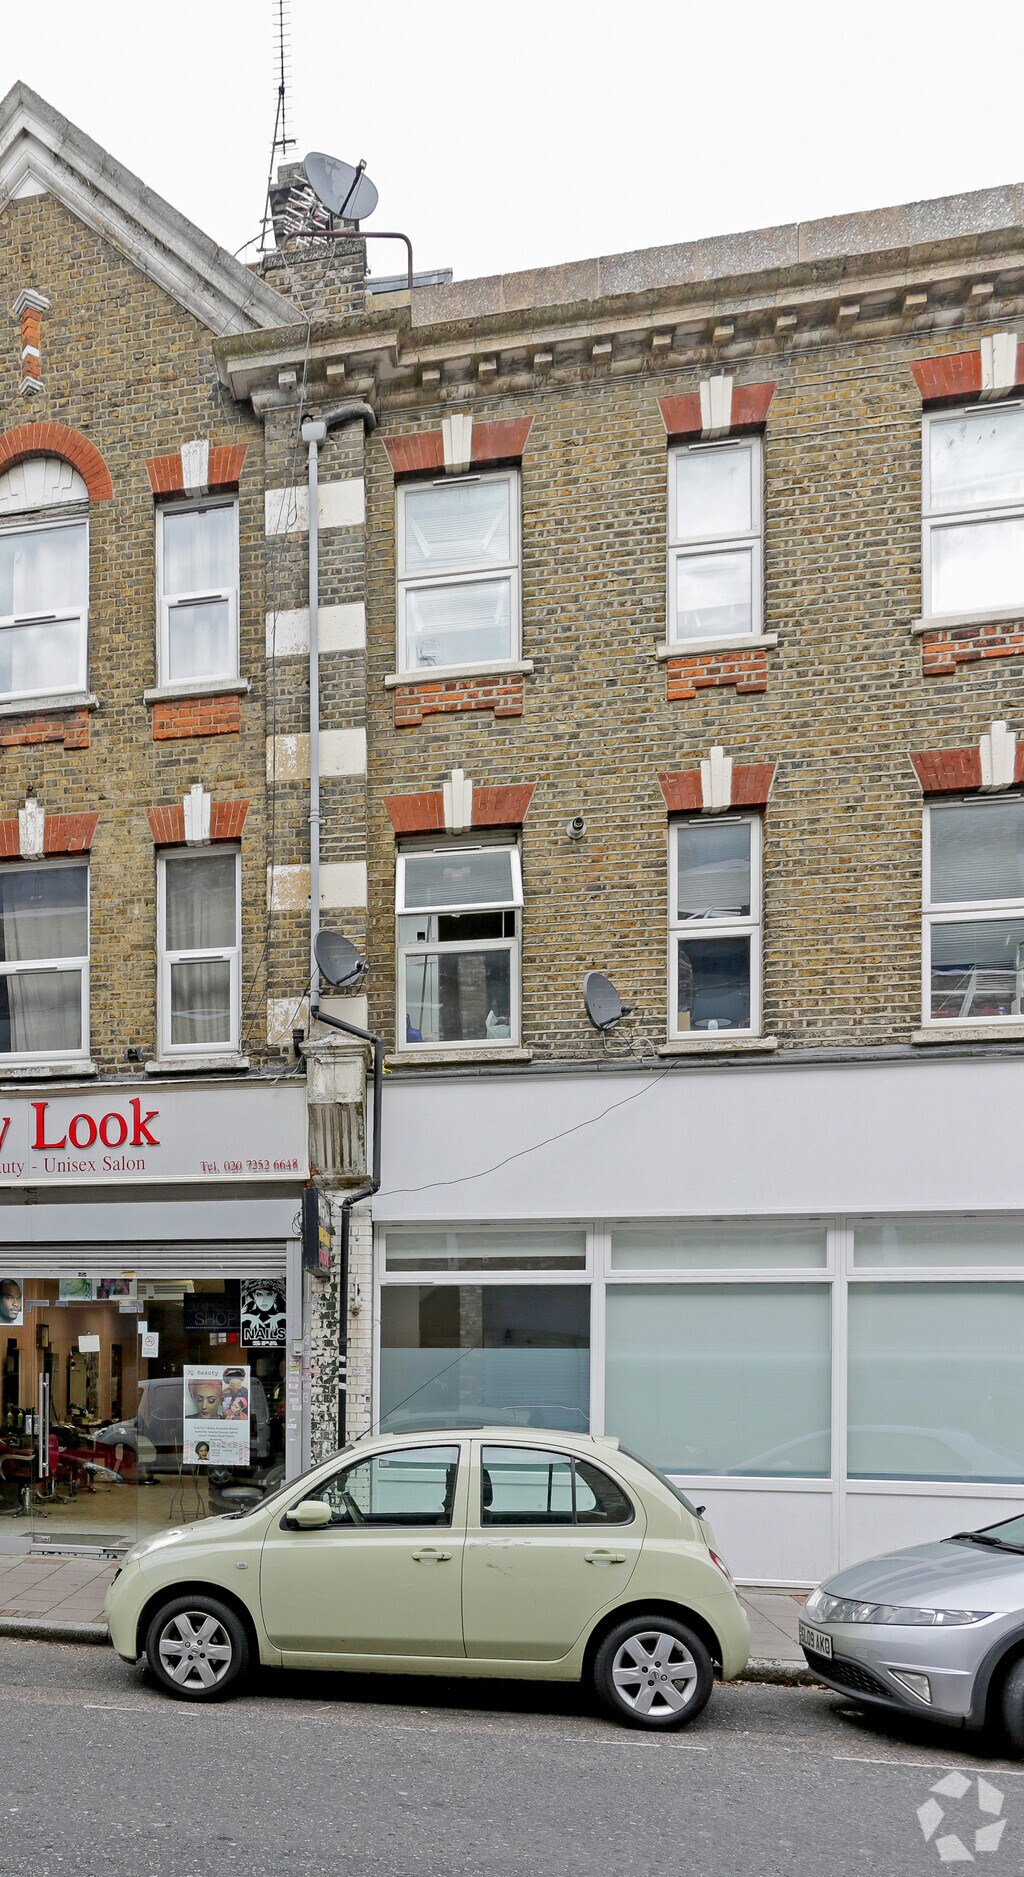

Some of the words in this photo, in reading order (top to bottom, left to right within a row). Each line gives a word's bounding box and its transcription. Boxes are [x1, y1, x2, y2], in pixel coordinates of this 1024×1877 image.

[31, 1097, 160, 1150] Look
[43, 1156, 96, 1173] Unisex
[103, 1155, 146, 1172] Salon
[224, 1160, 243, 1172] 020
[246, 1159, 270, 1172] 7252
[273, 1158, 298, 1171] 6648
[194, 1312, 237, 1327] SHOP
[244, 1328, 286, 1340] NAILS
